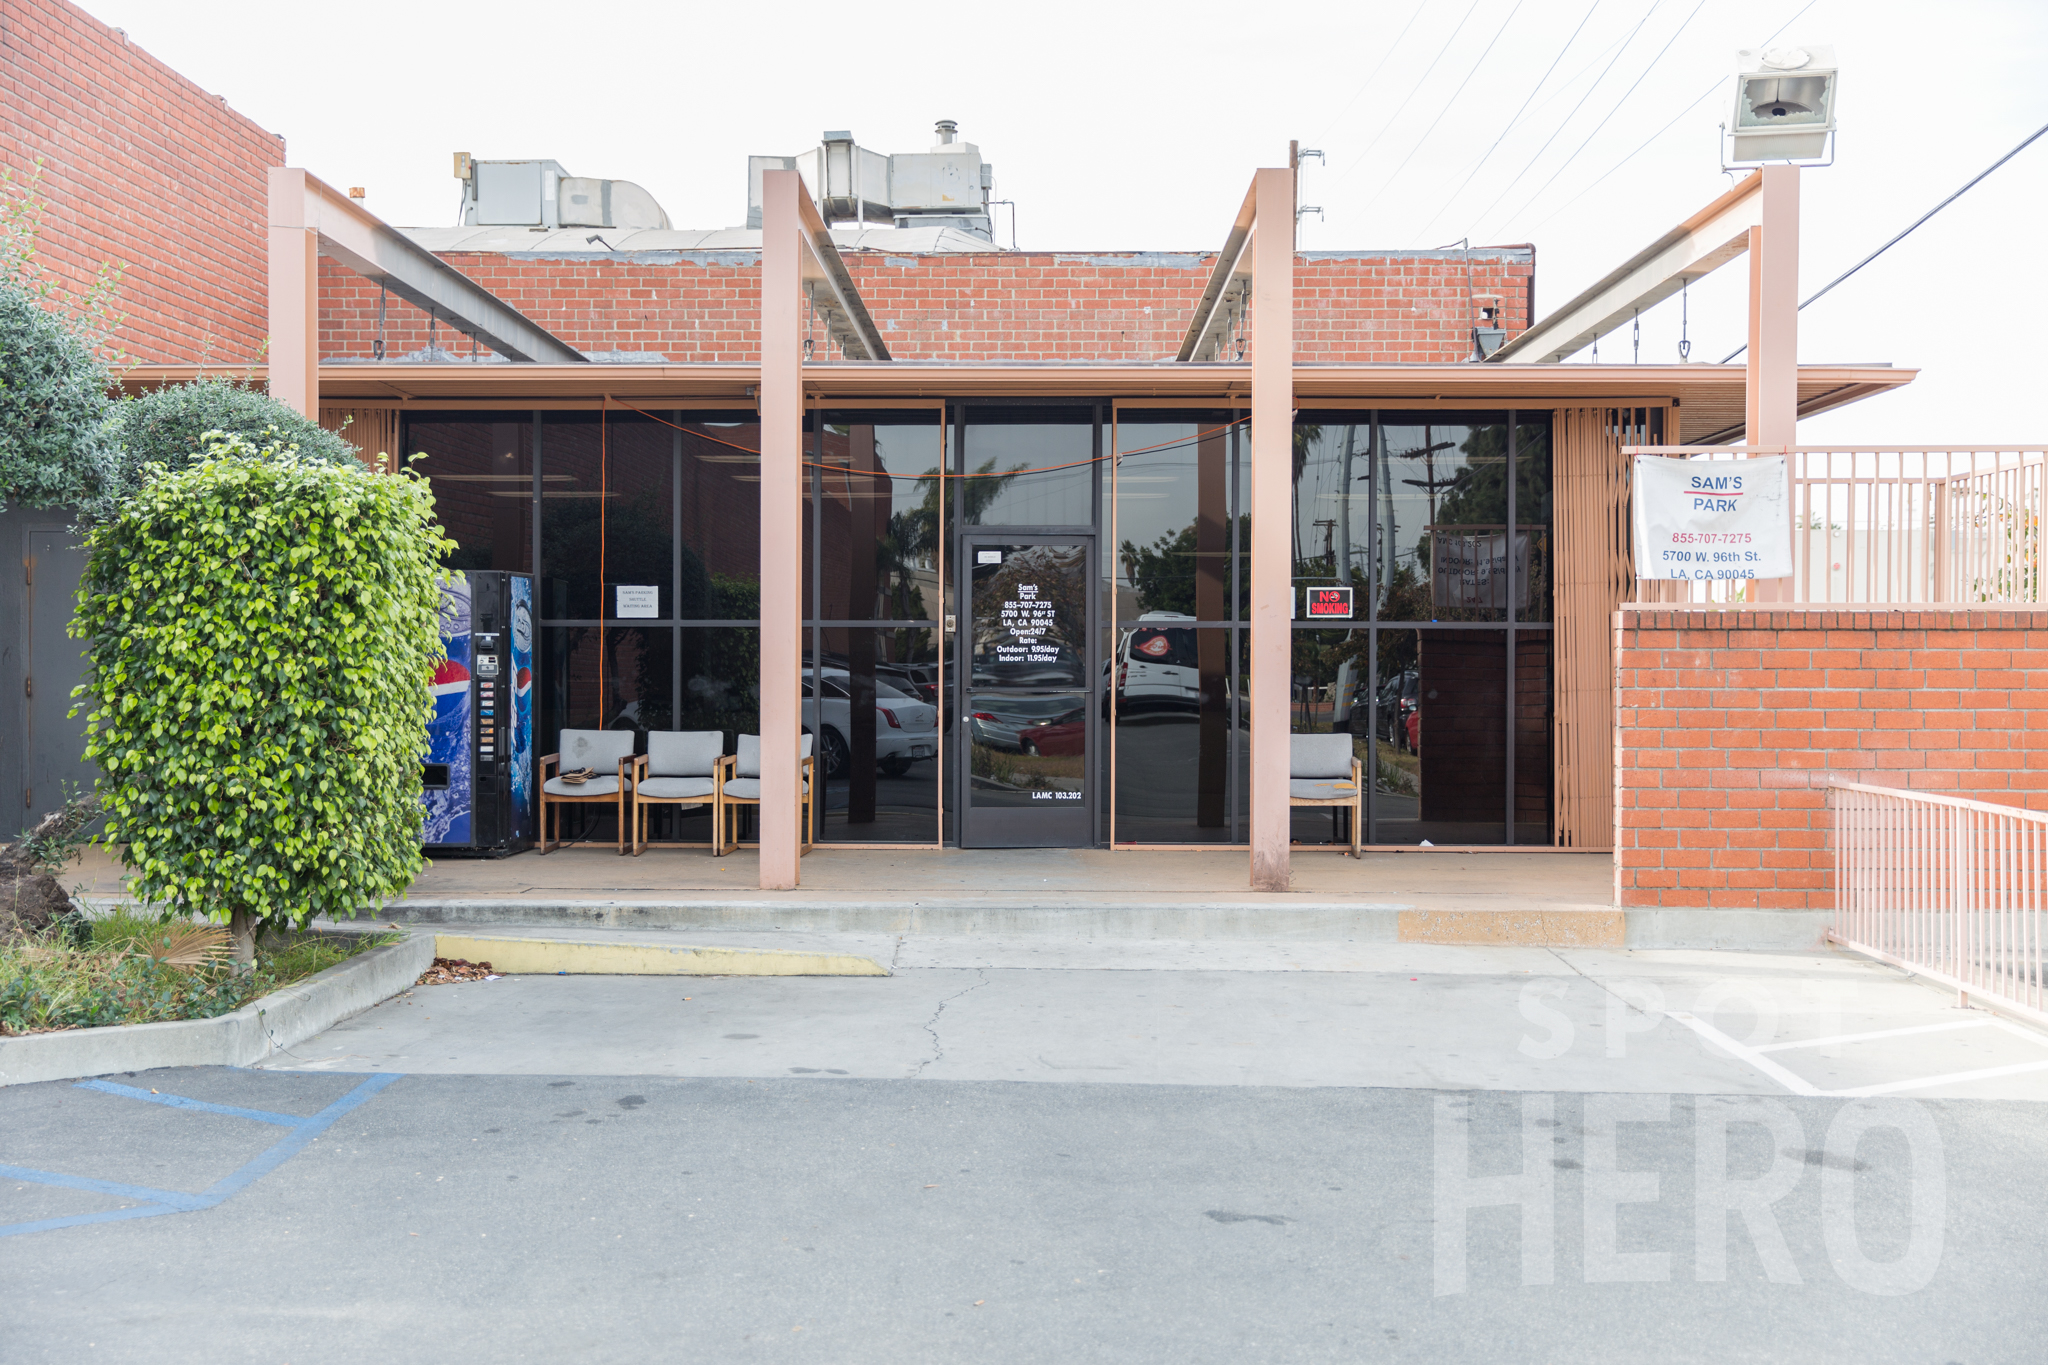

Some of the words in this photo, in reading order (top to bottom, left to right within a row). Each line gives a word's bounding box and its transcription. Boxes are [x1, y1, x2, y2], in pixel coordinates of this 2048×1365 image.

[1691, 476, 1743, 490] SAM'S
[1693, 498, 1738, 512] PARK
[1672, 533, 1752, 544] 855-707-7275
[1662, 550, 1692, 562] 5700
[1696, 552, 1710, 562] W.
[1713, 551, 1740, 562] 96th
[1744, 551, 1762, 562] St.
[1670, 569, 1690, 580] LA,
[1694, 569, 1714, 580] CA
[1717, 569, 1755, 580] 90045
[1019, 592, 1036, 600] Park
[1319, 591, 1341, 603] NO
[1004, 601, 1052, 609] 855-707-7275
[1311, 602, 1349, 614] SMOKING
[1001, 610, 1018, 618] 5700
[1021, 610, 1030, 618] W.
[1047, 610, 1055, 618] ST
[1002, 619, 1015, 627] LA,
[1017, 619, 1028, 627] CA
[1030, 619, 1053, 627] 90045
[1009, 628, 1046, 636] Open:24/7
[996, 645, 1029, 653] Outdoor:
[1031, 645, 1060, 654] 9.95/day
[998, 654, 1024, 662] Indoor:
[1027, 654, 1057, 663] 11.95/day
[1032, 791, 1053, 800] LAMC
[1055, 791, 1082, 800] 103.202
